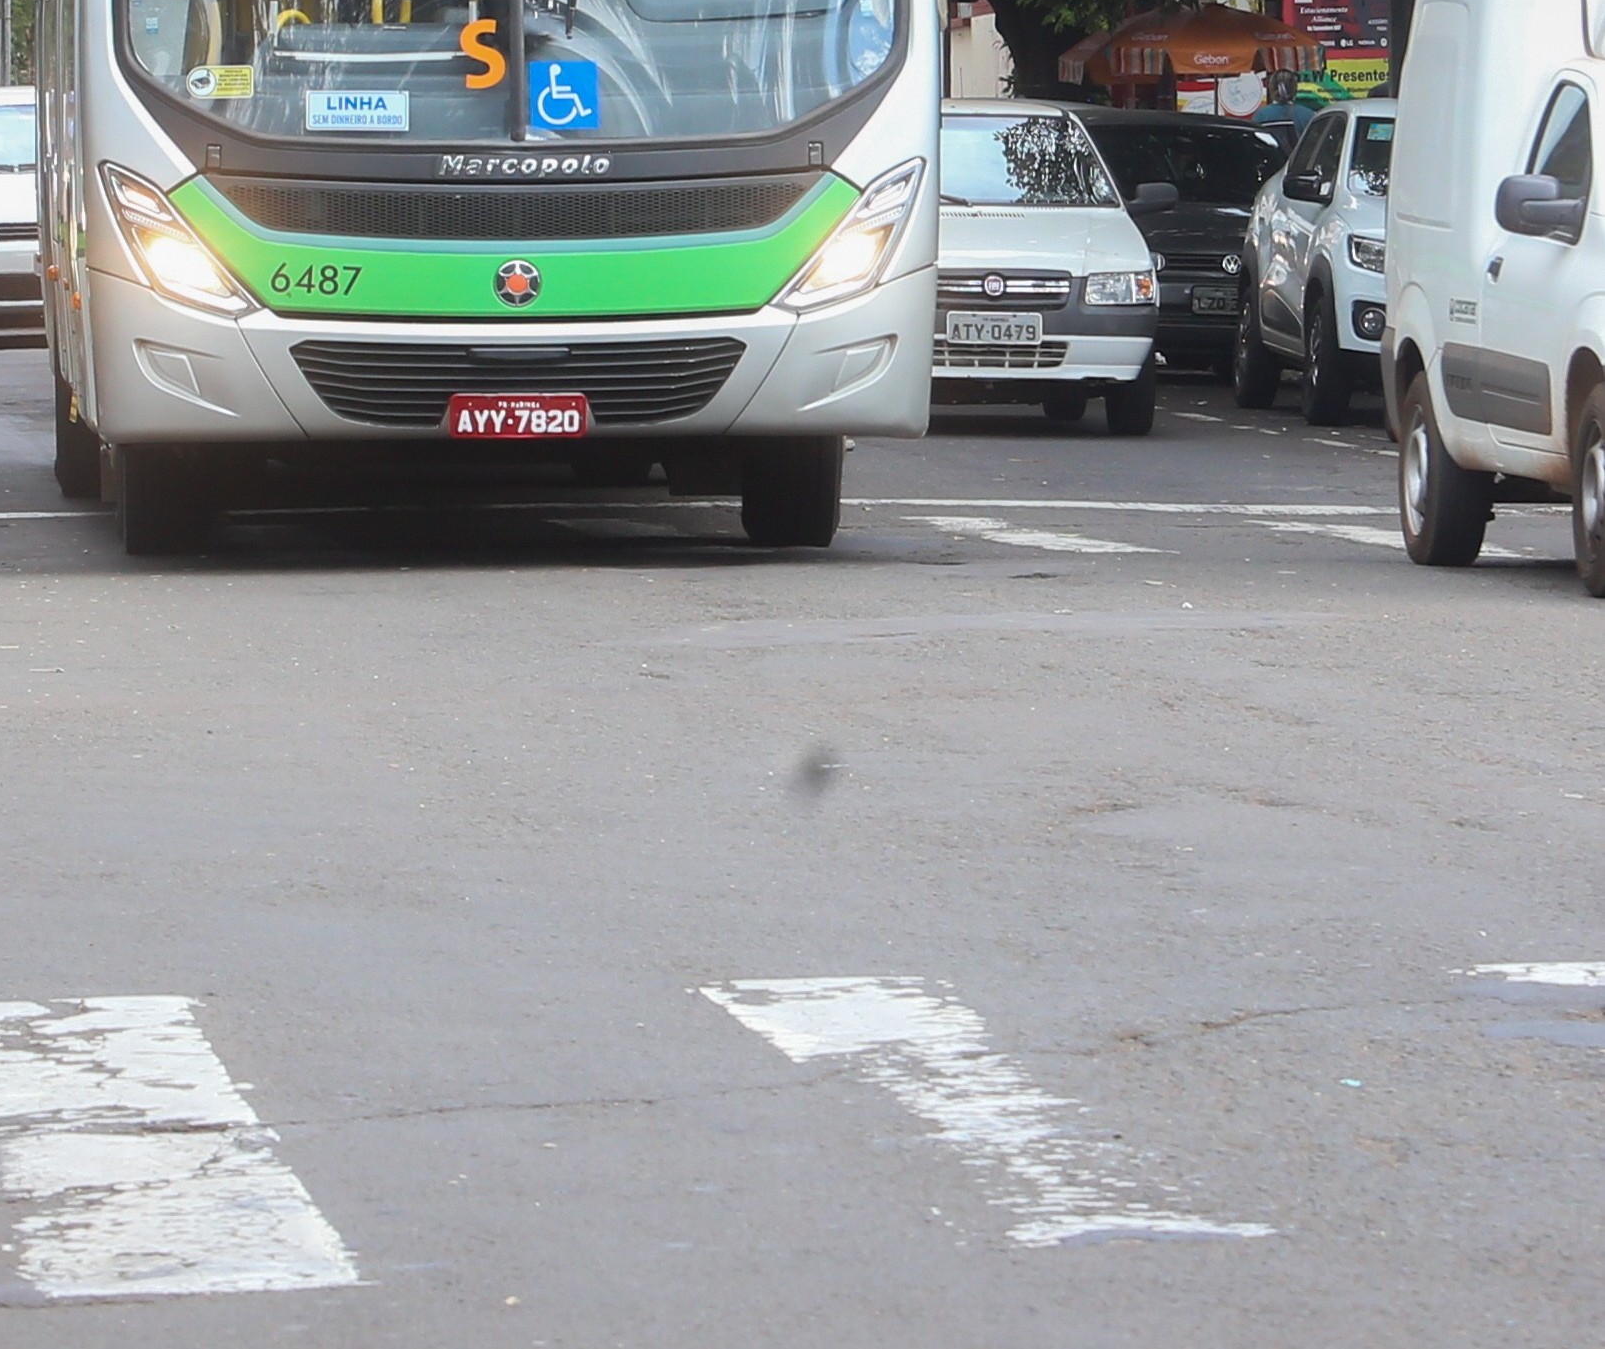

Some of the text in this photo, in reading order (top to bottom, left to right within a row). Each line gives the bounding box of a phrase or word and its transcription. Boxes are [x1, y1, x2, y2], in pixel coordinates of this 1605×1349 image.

[459, 18, 507, 90] S
[326, 96, 388, 111] LINHA
[312, 114, 403, 125] SEM DINHEIRO A BORDO
[439, 154, 610, 178] Marcopolo
[271, 262, 363, 296] 6487
